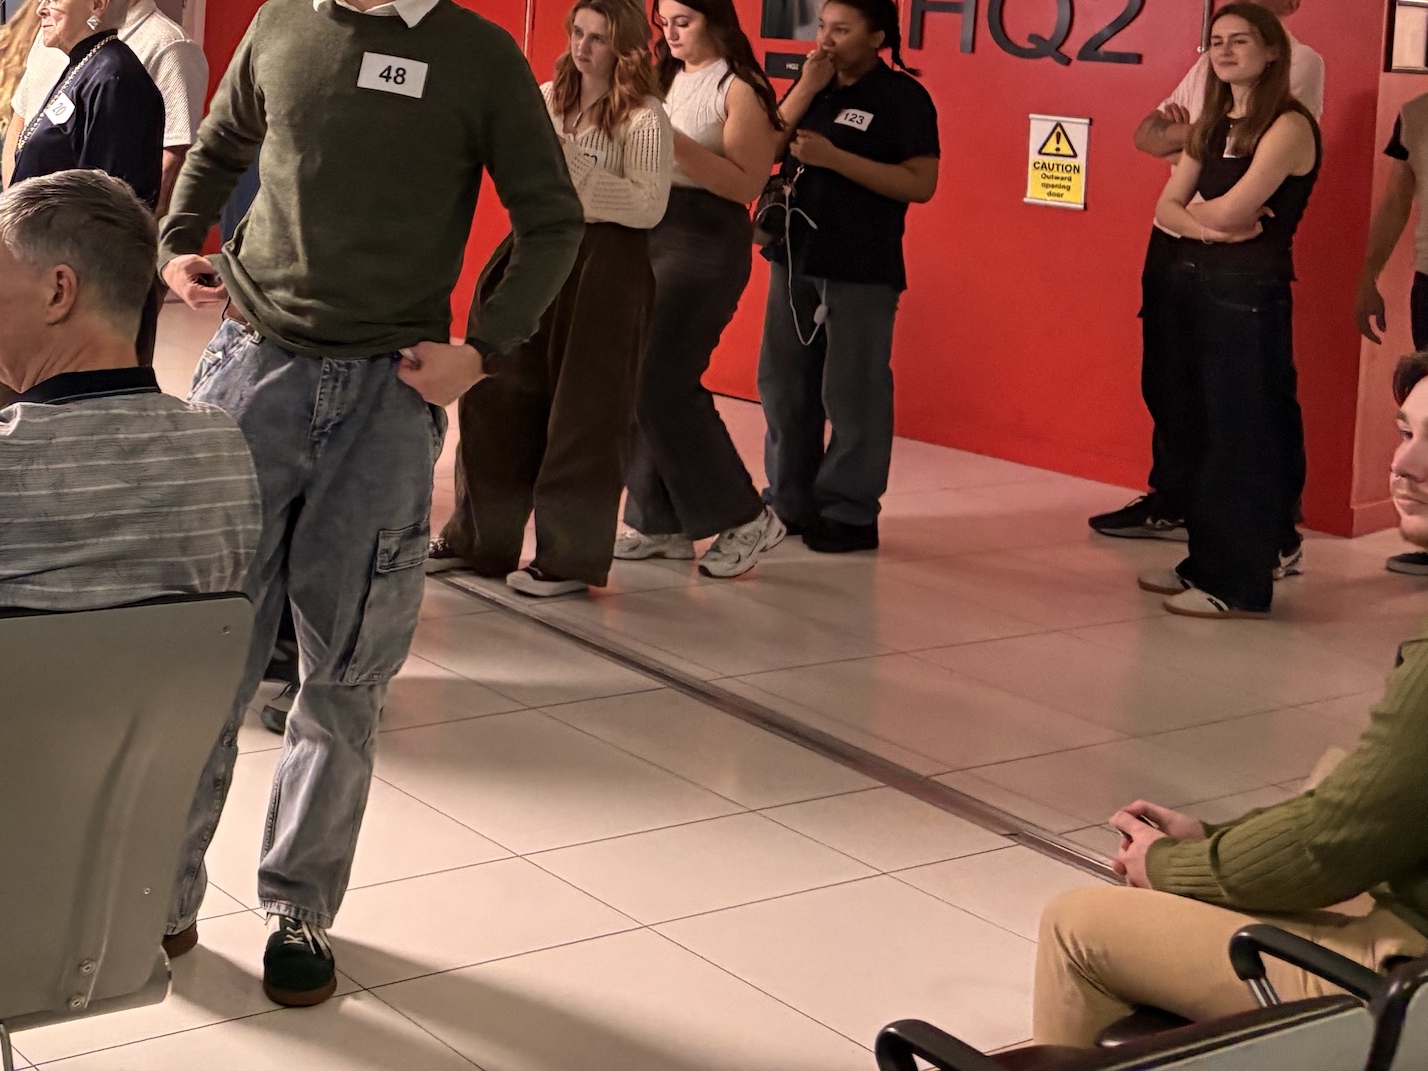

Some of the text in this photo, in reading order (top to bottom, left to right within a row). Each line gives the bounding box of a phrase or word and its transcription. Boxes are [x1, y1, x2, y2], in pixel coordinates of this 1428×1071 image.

[379, 65, 406, 85] 48
[52, 102, 67, 116] 20
[844, 113, 865, 125] 123
[1033, 161, 1080, 174] CAUTION
[1041, 173, 1072, 182] Outward
[1041, 182, 1071, 191] opening
